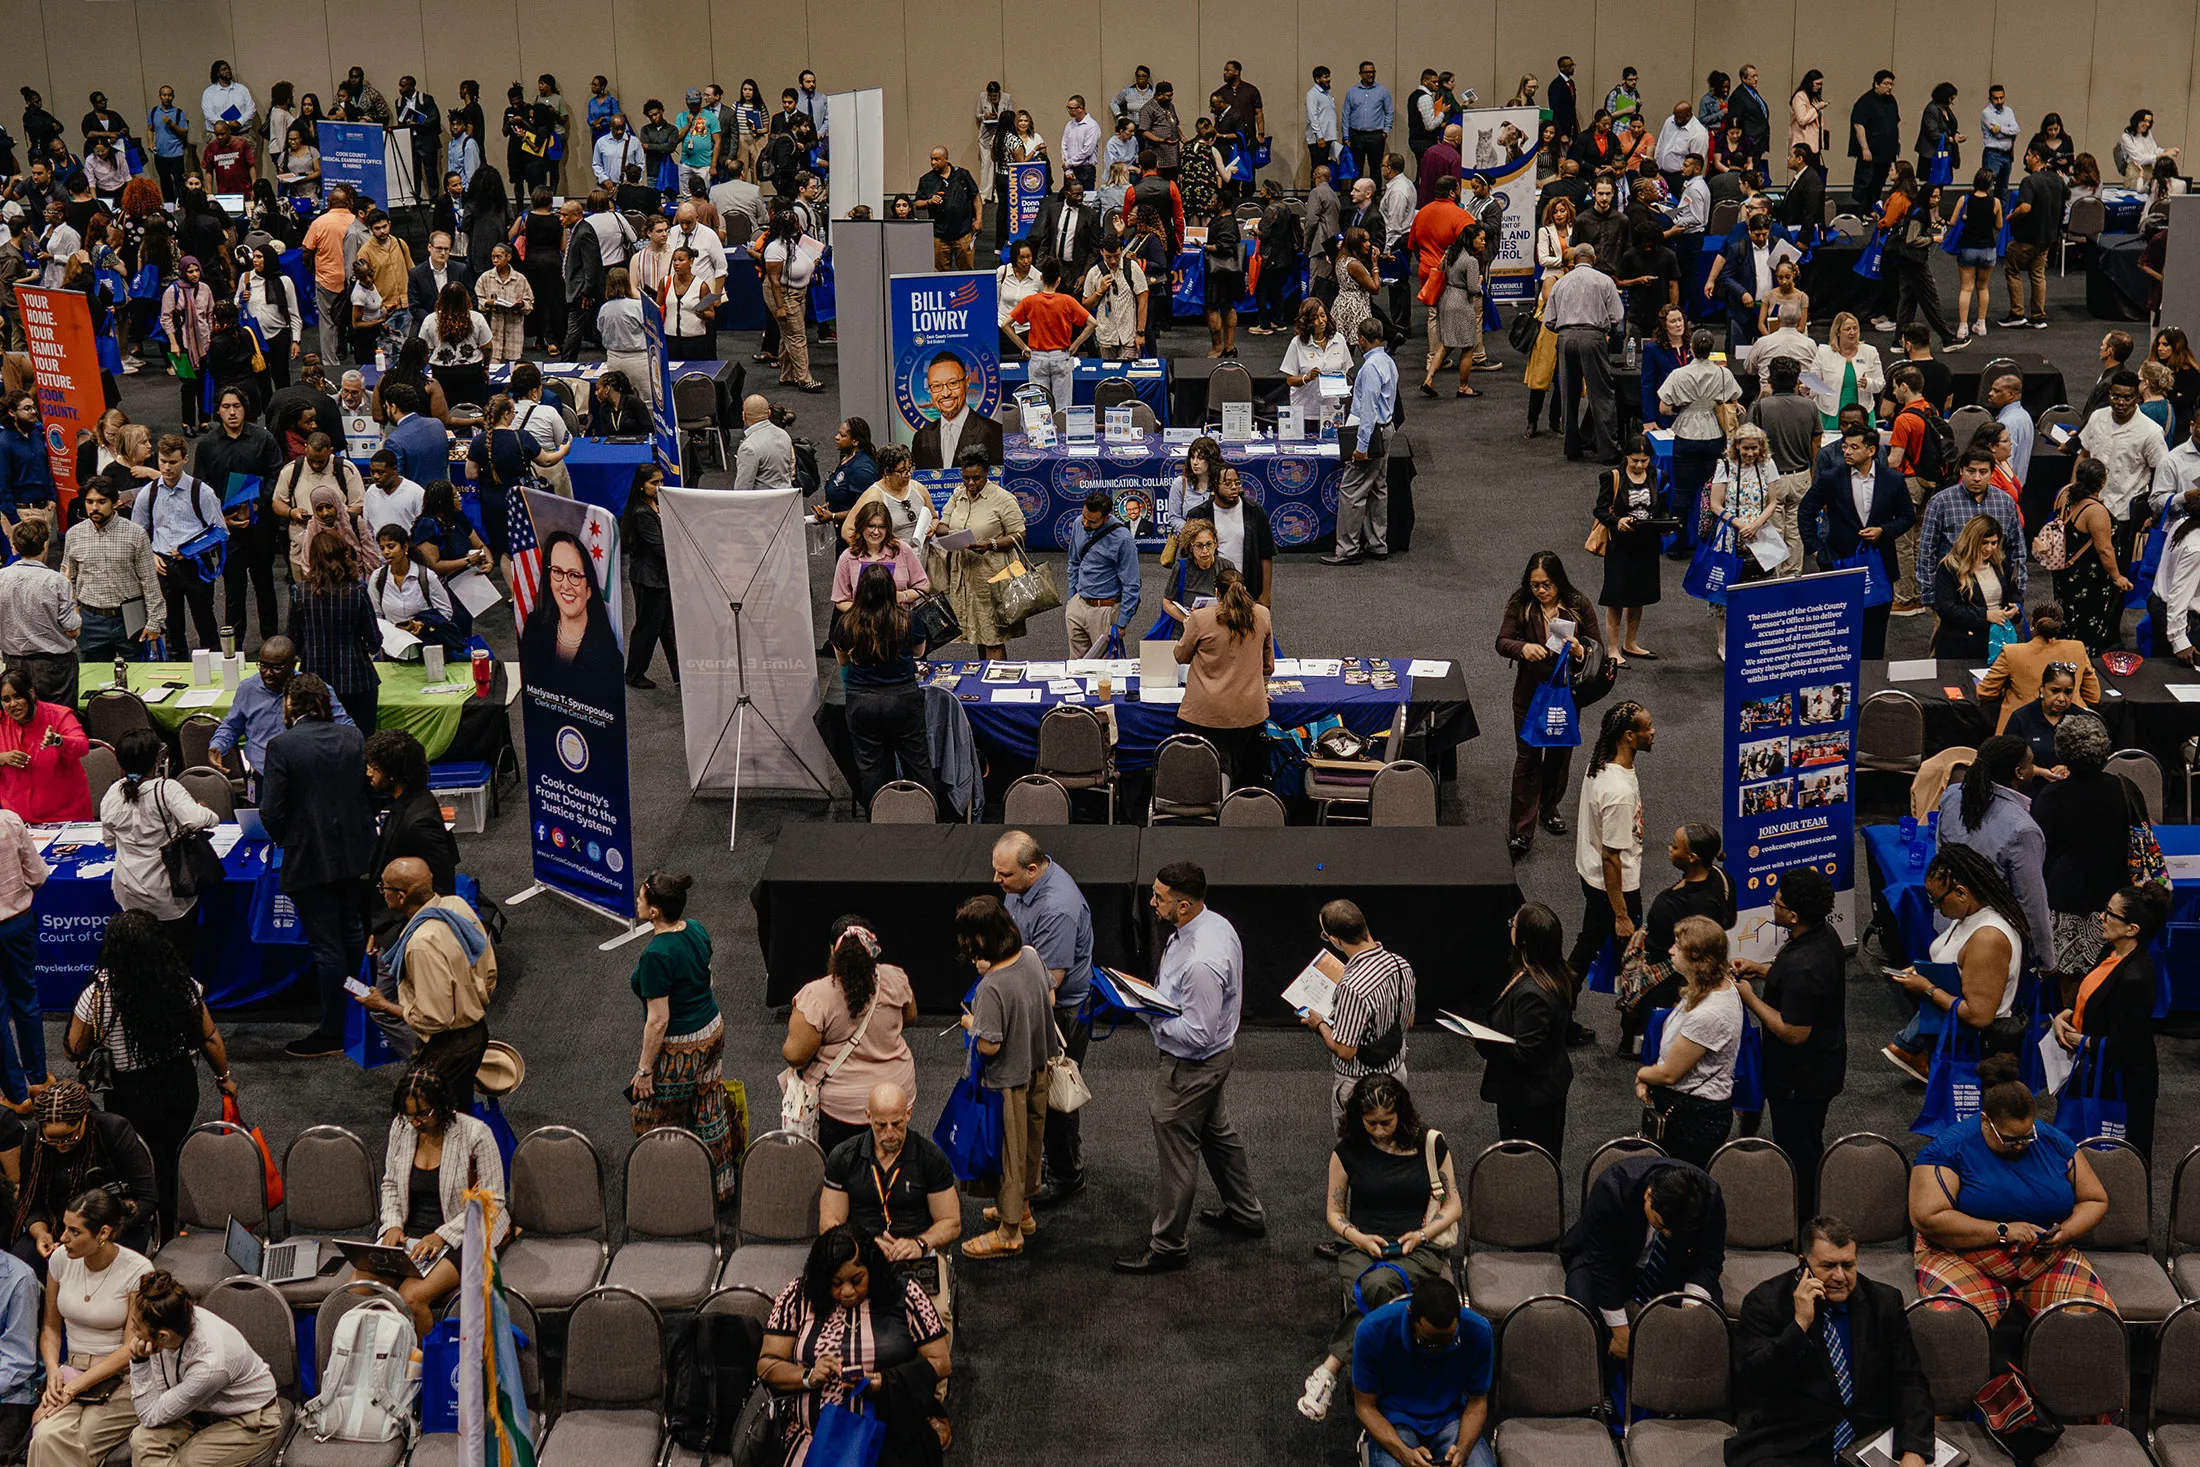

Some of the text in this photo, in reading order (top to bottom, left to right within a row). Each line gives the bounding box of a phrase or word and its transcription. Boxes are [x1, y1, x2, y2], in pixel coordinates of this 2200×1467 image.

[1009, 167, 1018, 234] COOK COUNTY
[1509, 231, 1530, 239] AND
[21, 293, 49, 309] YOUR
[911, 291, 946, 312] BILL
[26, 309, 57, 326] HOME.
[912, 310, 968, 332] LOWRY
[28, 324, 54, 341] YOUR
[31, 340, 66, 358] FAMILY.
[33, 356, 59, 372] YOUR
[36, 372, 75, 390] FUTURE.
[40, 388, 66, 403] COOK
[41, 404, 80, 420] COUNTY.
[1080, 478, 1141, 489] COMMUNICATION.
[1761, 610, 1787, 619] mission
[1787, 608, 1795, 616] of
[1807, 604, 1823, 613] Cook
[1824, 602, 1847, 610] County
[1752, 619, 1785, 630] Assessor's
[1786, 616, 1805, 624] Office
[1821, 611, 1843, 619] deliver
[1758, 629, 1785, 637] accurate
[1798, 621, 1836, 632] transparent
[1744, 638, 1784, 648] assessments
[1802, 629, 1836, 639] residential
[1837, 627, 1849, 635] and
[1760, 639, 1832, 655] commercial properties.
[1741, 653, 1852, 675] County through ethical stewardship
[1757, 657, 1774, 665] serve
[1775, 654, 1791, 663] every
[1792, 648, 1828, 658] community
[1747, 673, 1768, 683] within
[1769, 672, 1779, 680] the
[1780, 668, 1807, 679] property
[1819, 664, 1844, 673] system.
[526, 684, 614, 721] Mariyana T. Spyropoulos
[534, 698, 550, 708] Clerk
[557, 706, 568, 715] the
[568, 709, 588, 722] Circuit
[589, 717, 606, 728] Court
[541, 774, 609, 808] Cook County's
[535, 785, 617, 825] Front Door to the
[542, 800, 612, 836] Justice System
[1758, 816, 1828, 837] JOIN OUR TEAM
[1761, 834, 1837, 854] cookcountyassessor.com
[1749, 864, 1771, 873] Connect
[1772, 861, 1785, 869] with
[1801, 854, 1818, 864] social
[1818, 852, 1836, 860] media
[42, 914, 111, 929] Spyropo
[39, 932, 75, 942] Court
[78, 931, 91, 942] of
